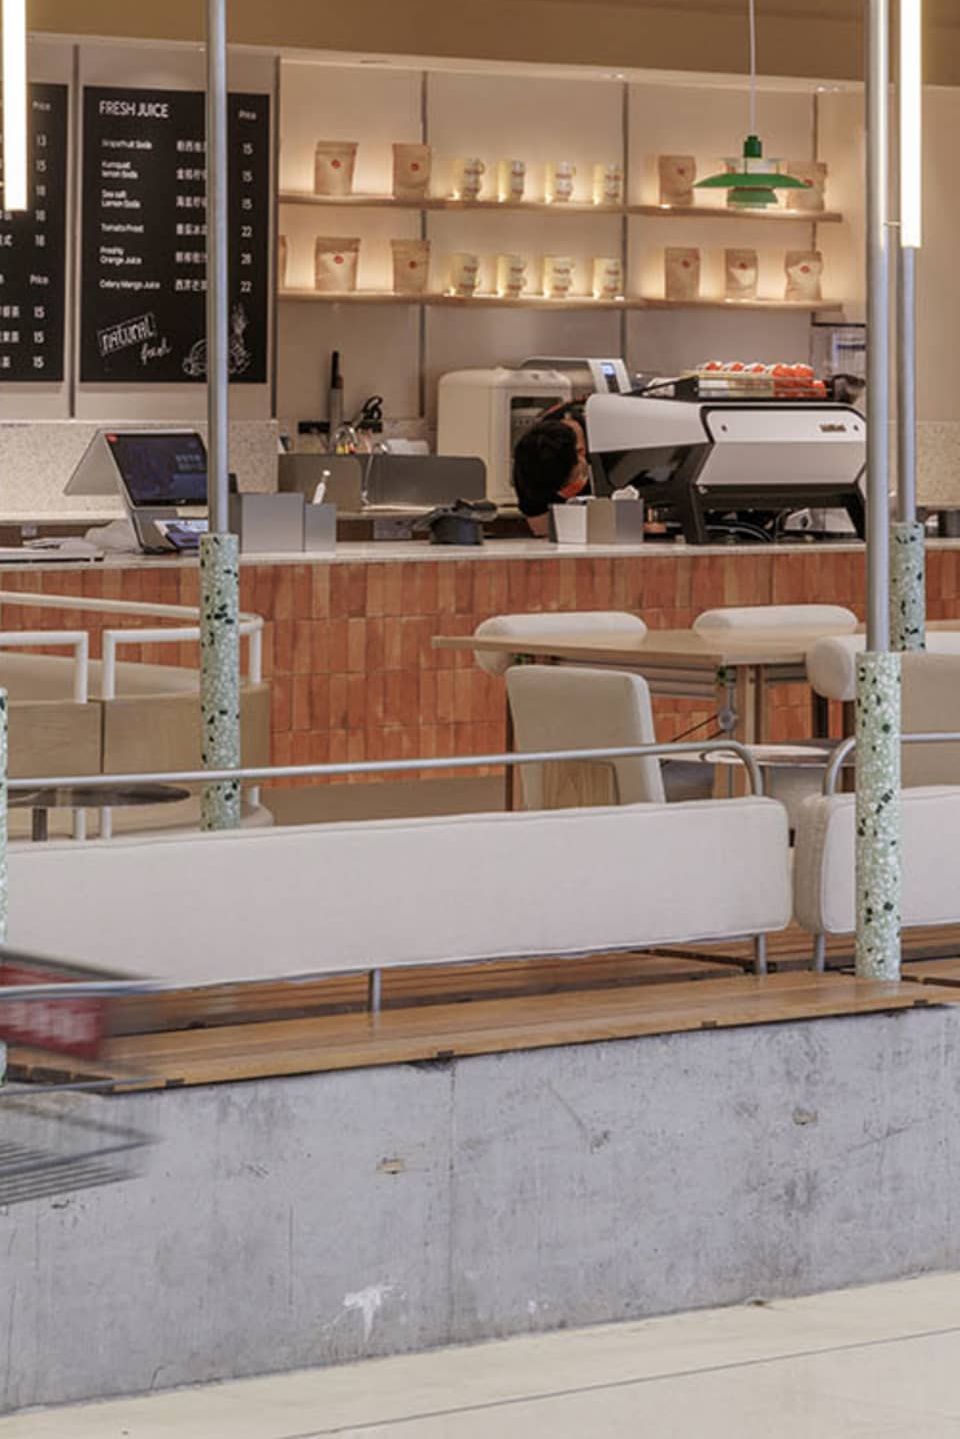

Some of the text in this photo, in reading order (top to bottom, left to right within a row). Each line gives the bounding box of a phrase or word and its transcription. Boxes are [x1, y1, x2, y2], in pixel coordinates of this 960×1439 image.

[99, 101, 169, 118] FRESH JUICE
[243, 143, 253, 155] 15
[36, 159, 47, 172] 15
[243, 170, 253, 182] 15
[243, 198, 253, 210] 15
[241, 226, 252, 237] 22
[29, 274, 49, 285] Price
[241, 281, 252, 292] 22
[34, 306, 45, 319] 15
[33, 331, 44, 344] 15
[32, 356, 45, 369] 15
